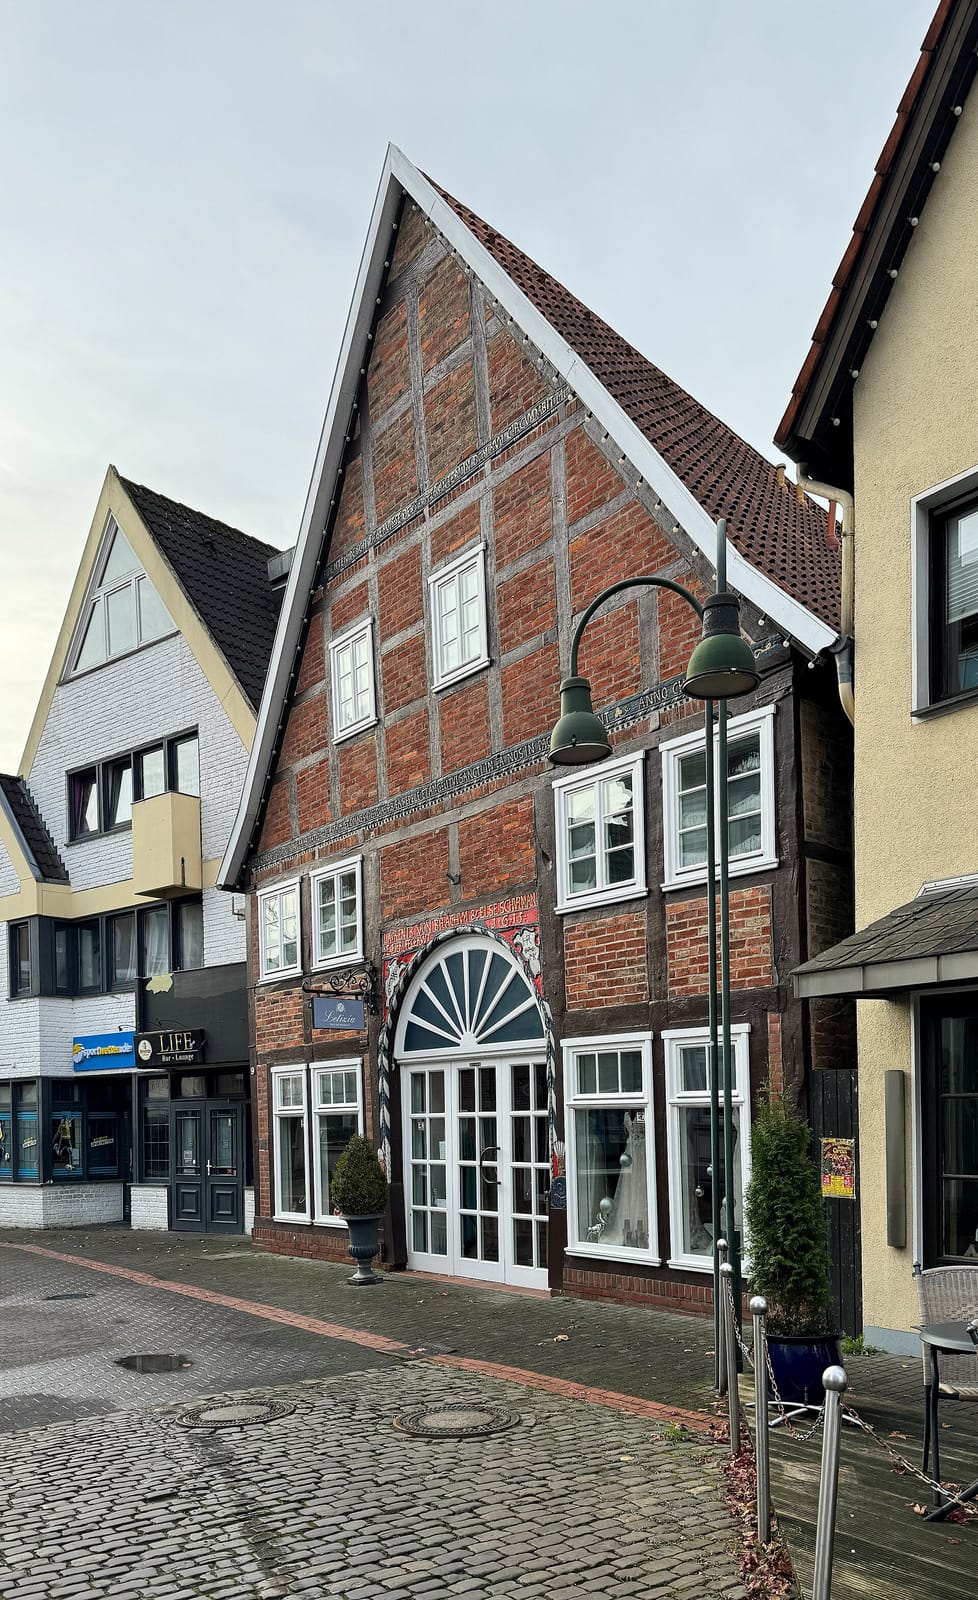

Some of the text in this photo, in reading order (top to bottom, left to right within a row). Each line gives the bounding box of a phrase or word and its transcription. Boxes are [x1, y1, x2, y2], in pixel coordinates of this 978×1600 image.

[639, 687, 668, 709] ANNO
[507, 747, 522, 764] NOS
[324, 1010, 356, 1024] Letizia
[159, 1032, 192, 1053] LIFE
[162, 1054, 194, 1063] Bar Lounge
